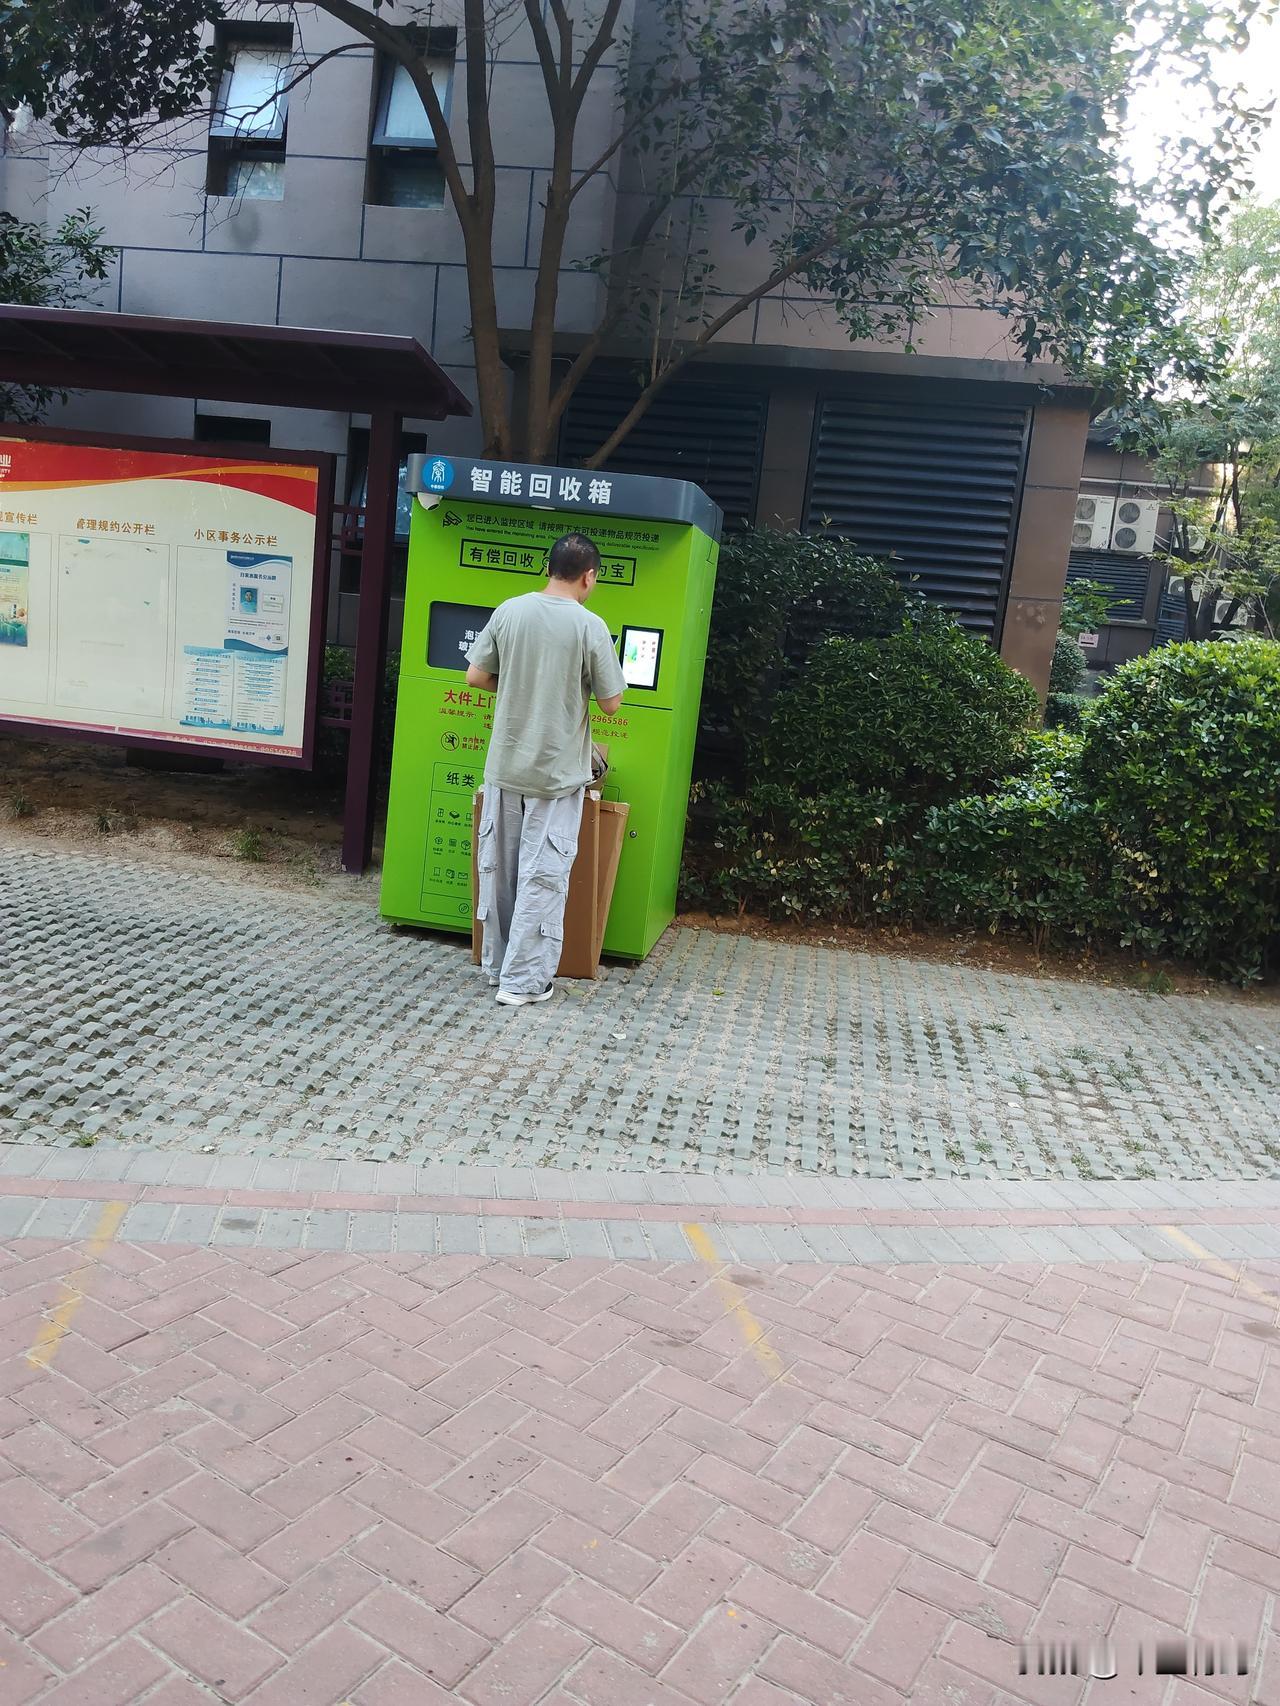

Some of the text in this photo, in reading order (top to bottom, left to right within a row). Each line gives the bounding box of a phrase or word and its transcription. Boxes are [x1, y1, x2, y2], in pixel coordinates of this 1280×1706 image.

[470, 466, 613, 505] 智能回收箱
[193, 528, 278, 547] 小区事务公示栏
[469, 546, 534, 569] 有偿回收
[590, 714, 629, 726] 2965586
[445, 770, 476, 789] 纸类
